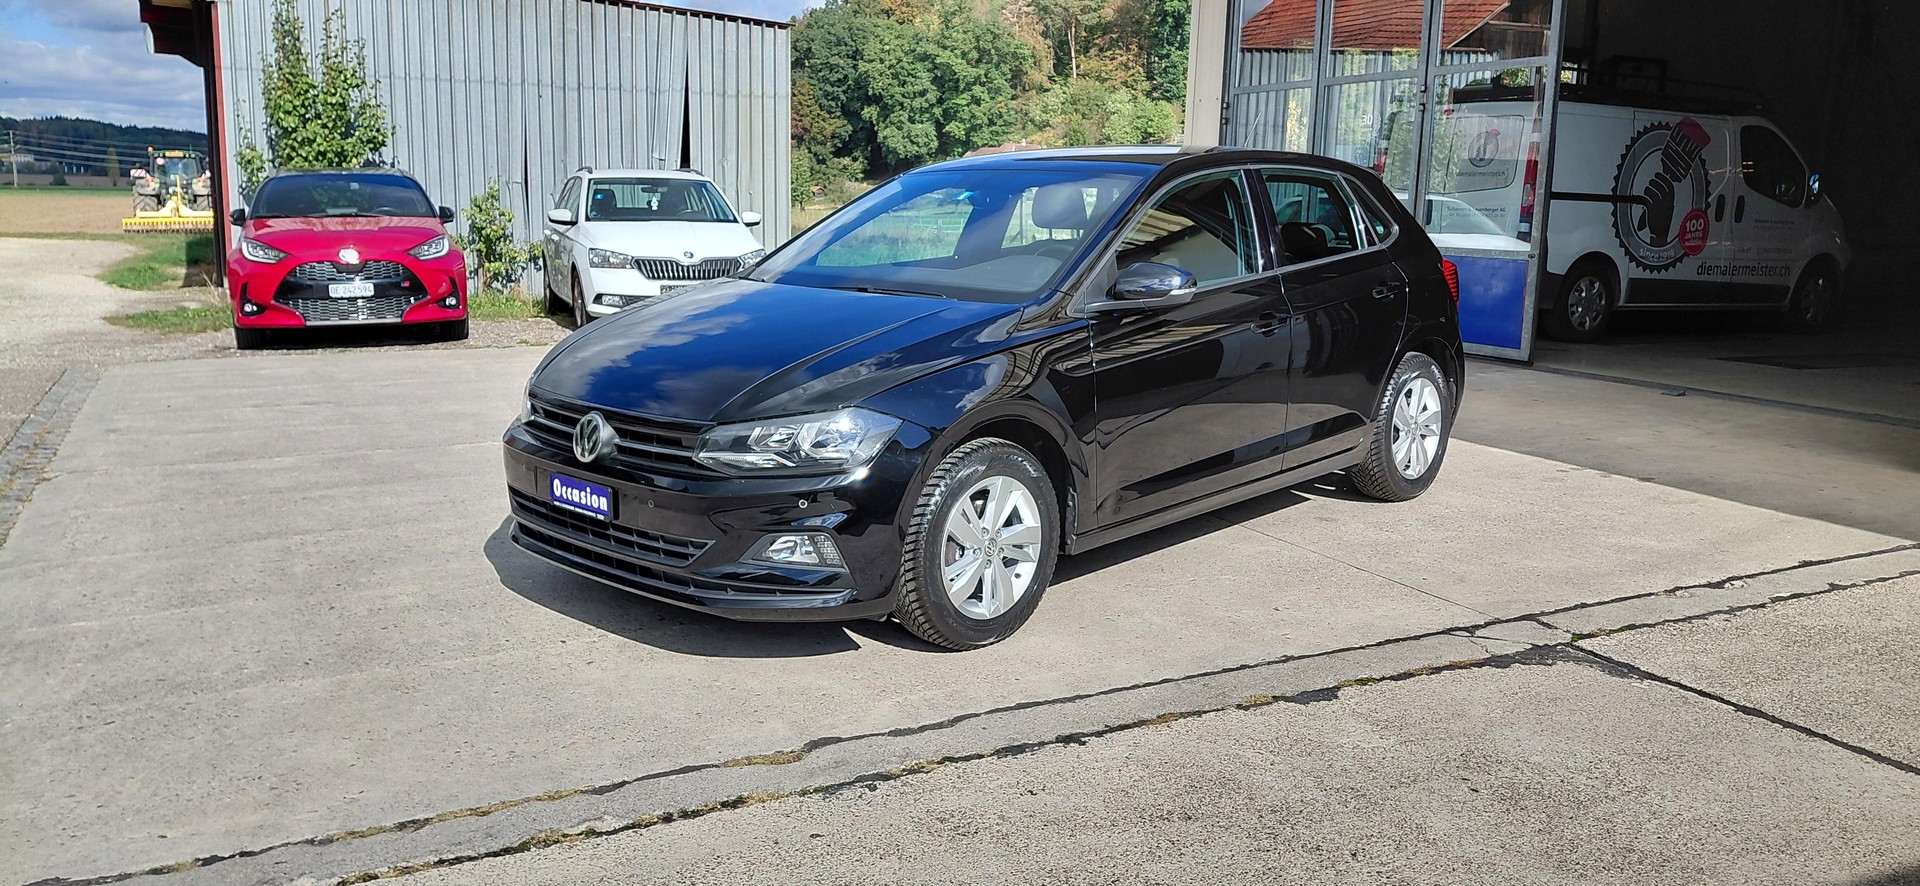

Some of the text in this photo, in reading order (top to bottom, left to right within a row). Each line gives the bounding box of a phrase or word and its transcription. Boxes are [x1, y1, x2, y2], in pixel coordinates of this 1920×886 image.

[1685, 218, 1704, 232] 100
[1639, 247, 1659, 262] since
[1696, 261, 1791, 277] diemalermeister.ch
[553, 478, 608, 511] Occasion
